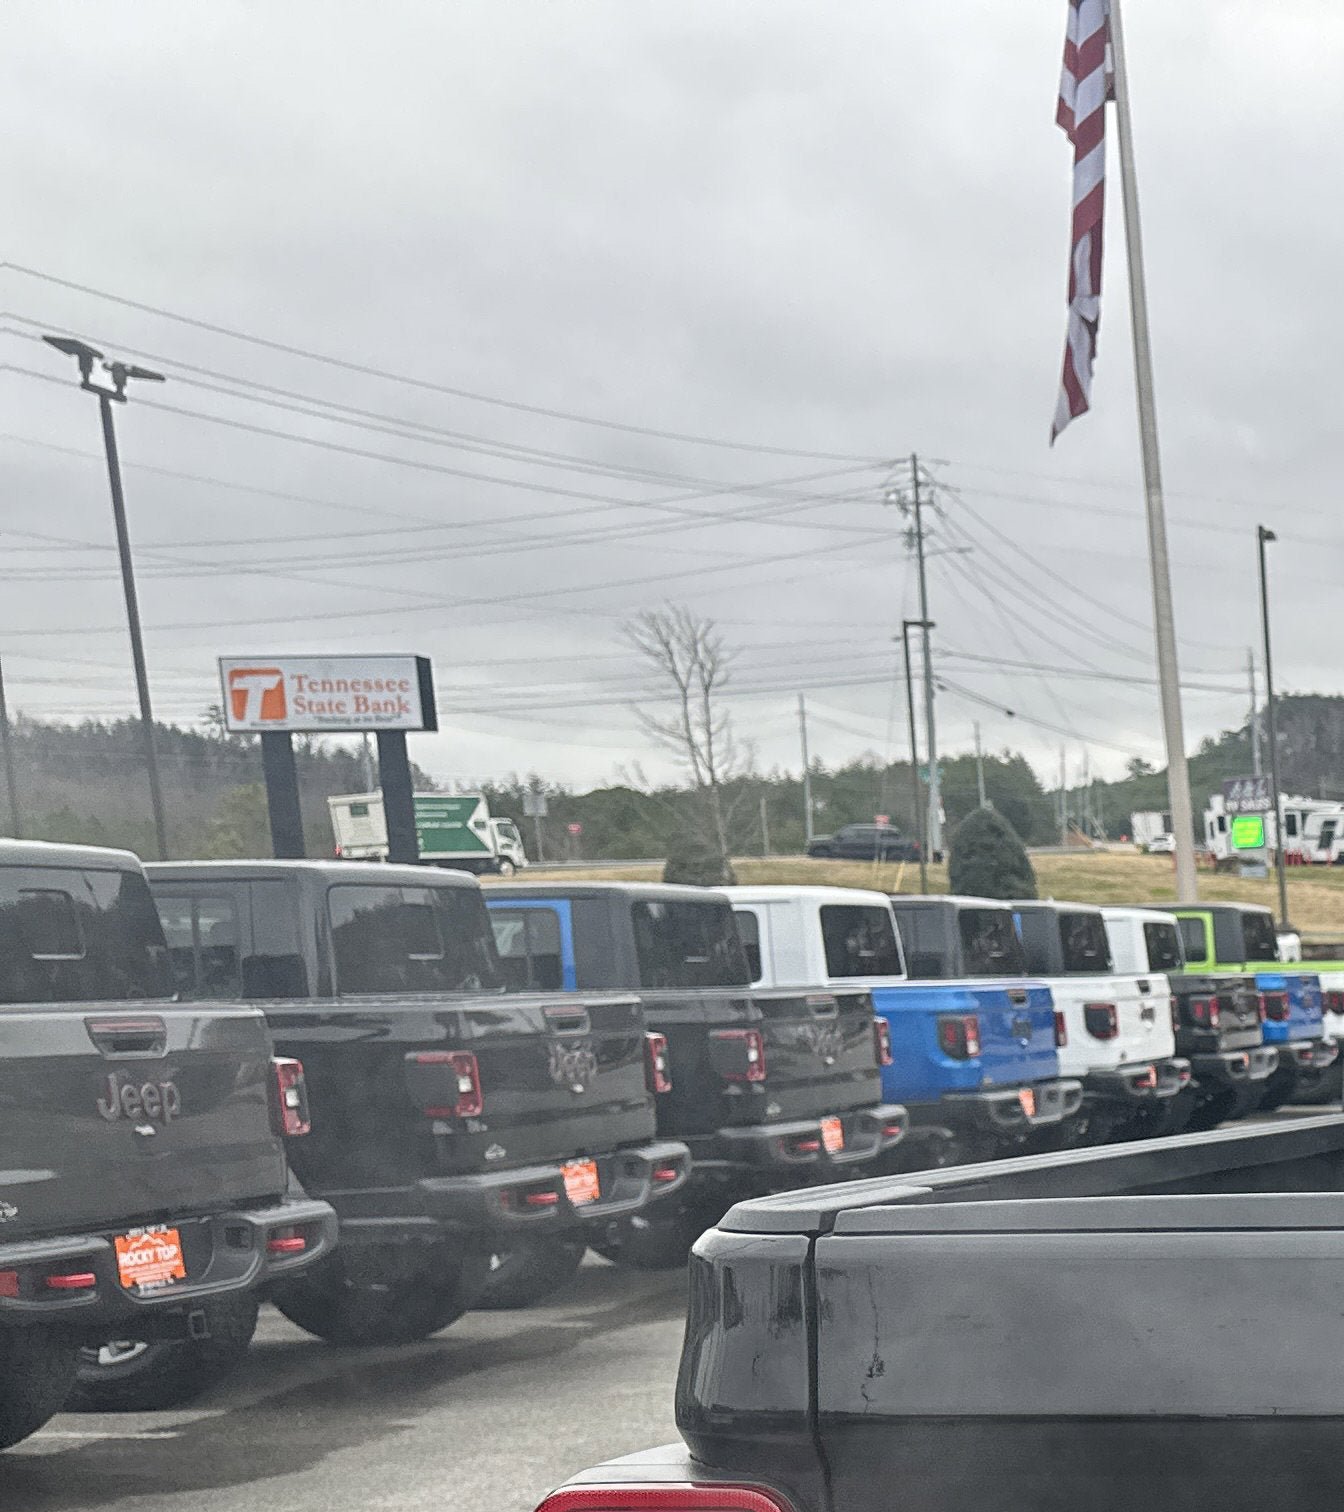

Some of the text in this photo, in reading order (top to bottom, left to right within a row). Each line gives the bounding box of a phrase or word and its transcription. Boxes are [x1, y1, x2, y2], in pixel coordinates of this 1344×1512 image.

[290, 673, 410, 693] Tennessee
[293, 695, 411, 715] State Bank
[95, 1071, 182, 1123] Jeep
[118, 1244, 179, 1267] ROCKY TOP
